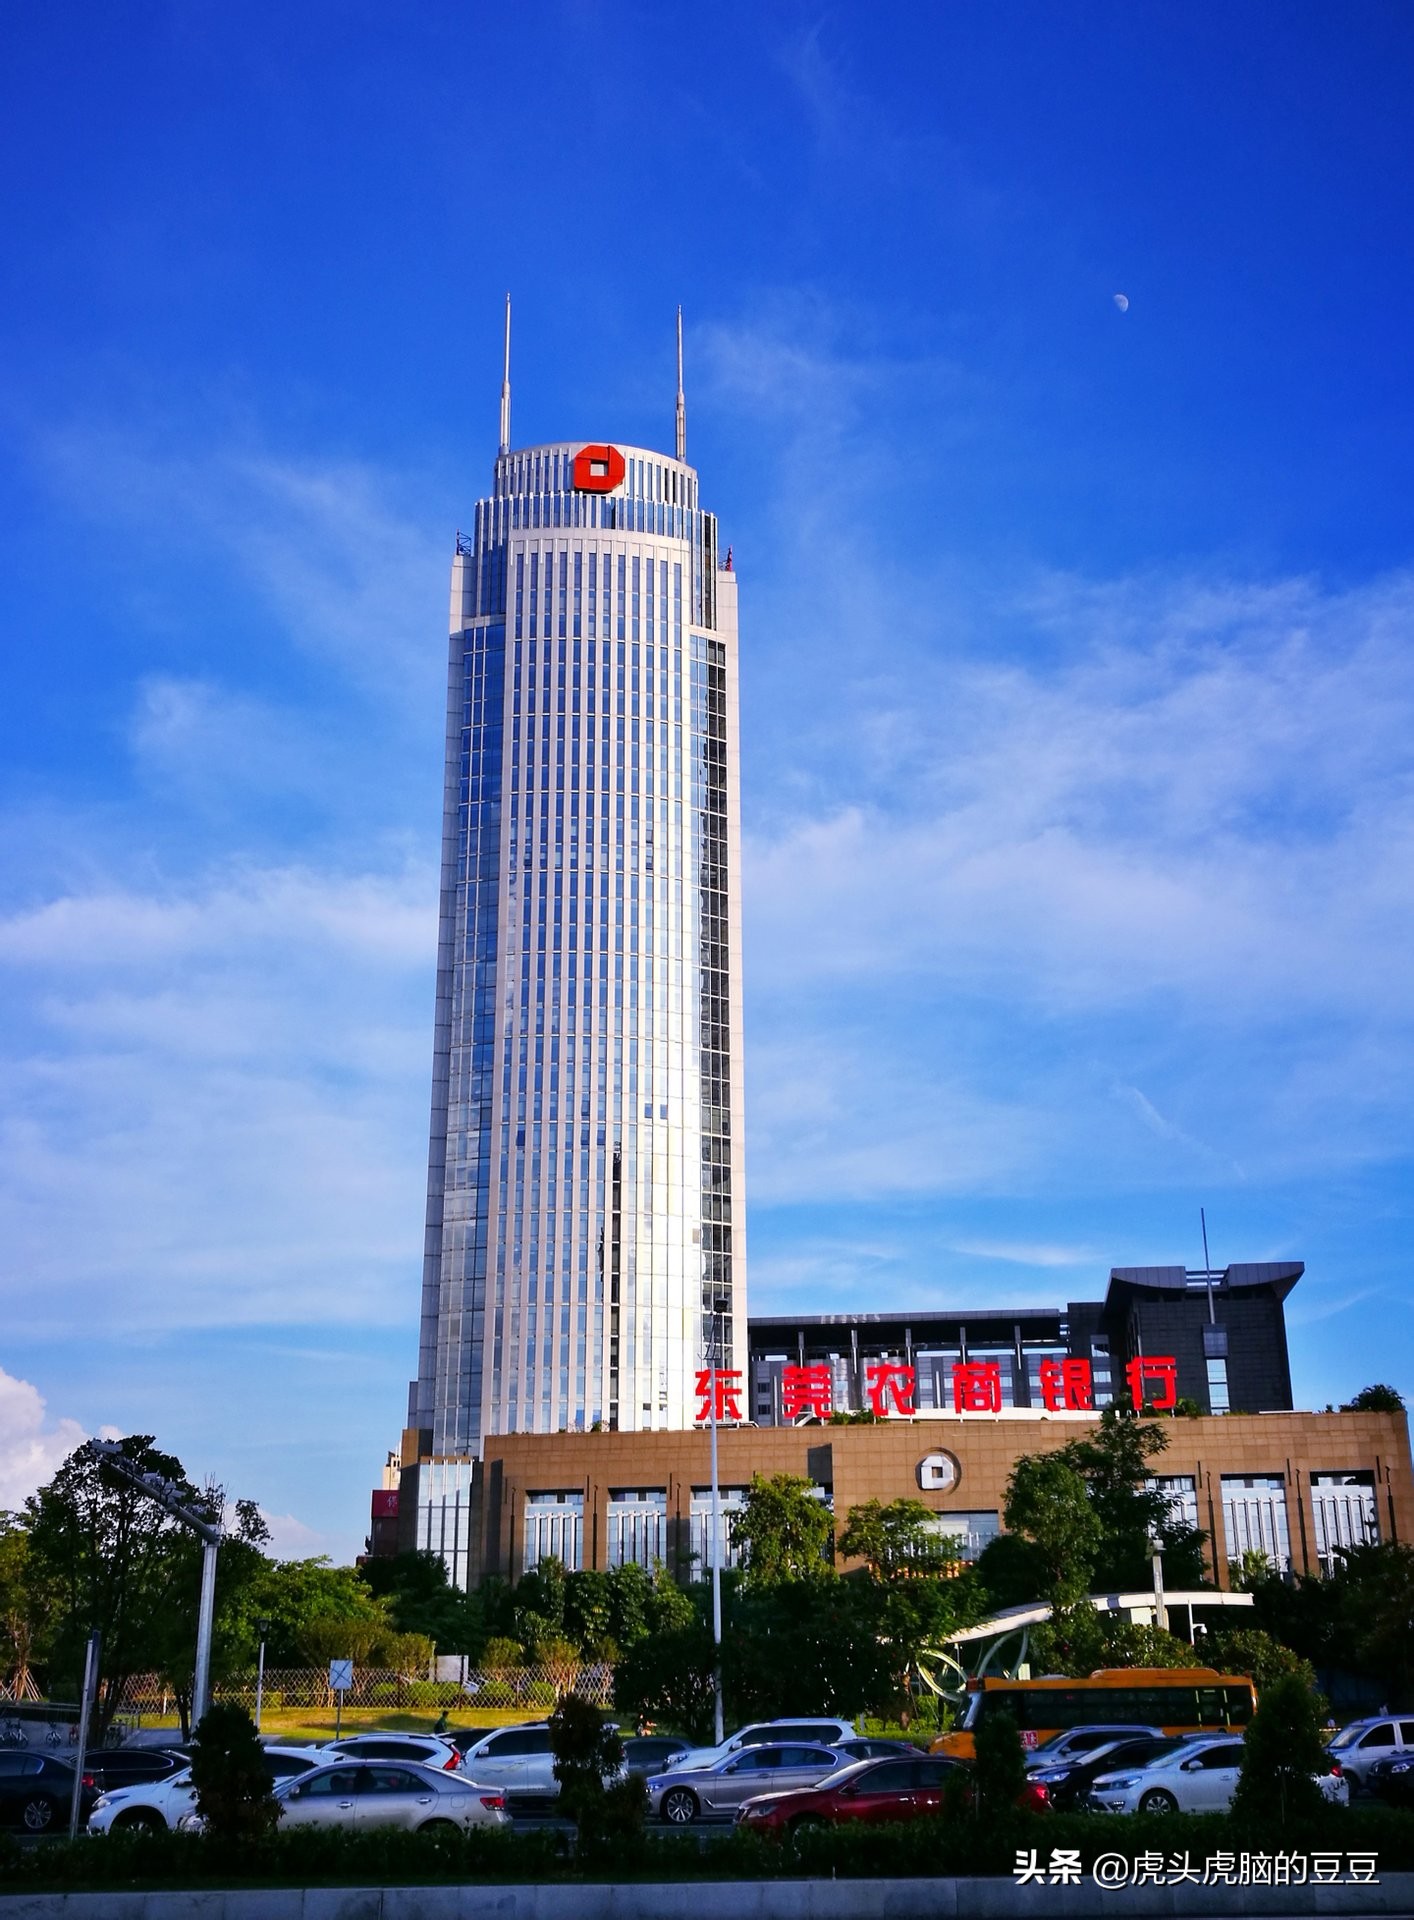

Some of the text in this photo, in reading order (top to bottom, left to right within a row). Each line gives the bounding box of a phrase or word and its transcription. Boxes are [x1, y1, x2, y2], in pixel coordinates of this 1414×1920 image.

[695, 1356, 1178, 1421] 东莞农商银行
